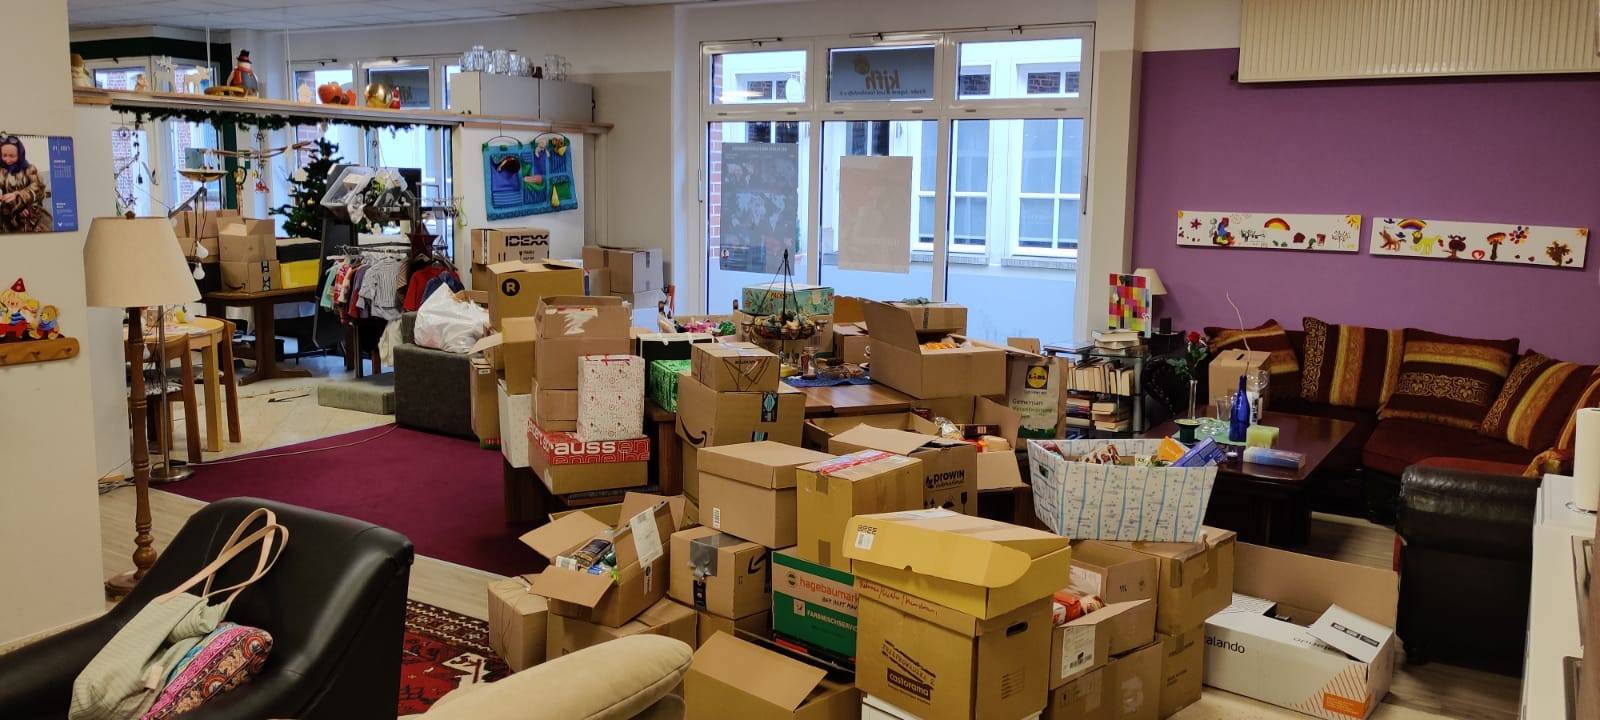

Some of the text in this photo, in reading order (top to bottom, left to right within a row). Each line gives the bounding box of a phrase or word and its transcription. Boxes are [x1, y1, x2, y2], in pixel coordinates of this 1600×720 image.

[505, 234, 549, 247] IDEXX
[799, 576, 859, 602] hagebaumark
[1205, 634, 1246, 654] alando
